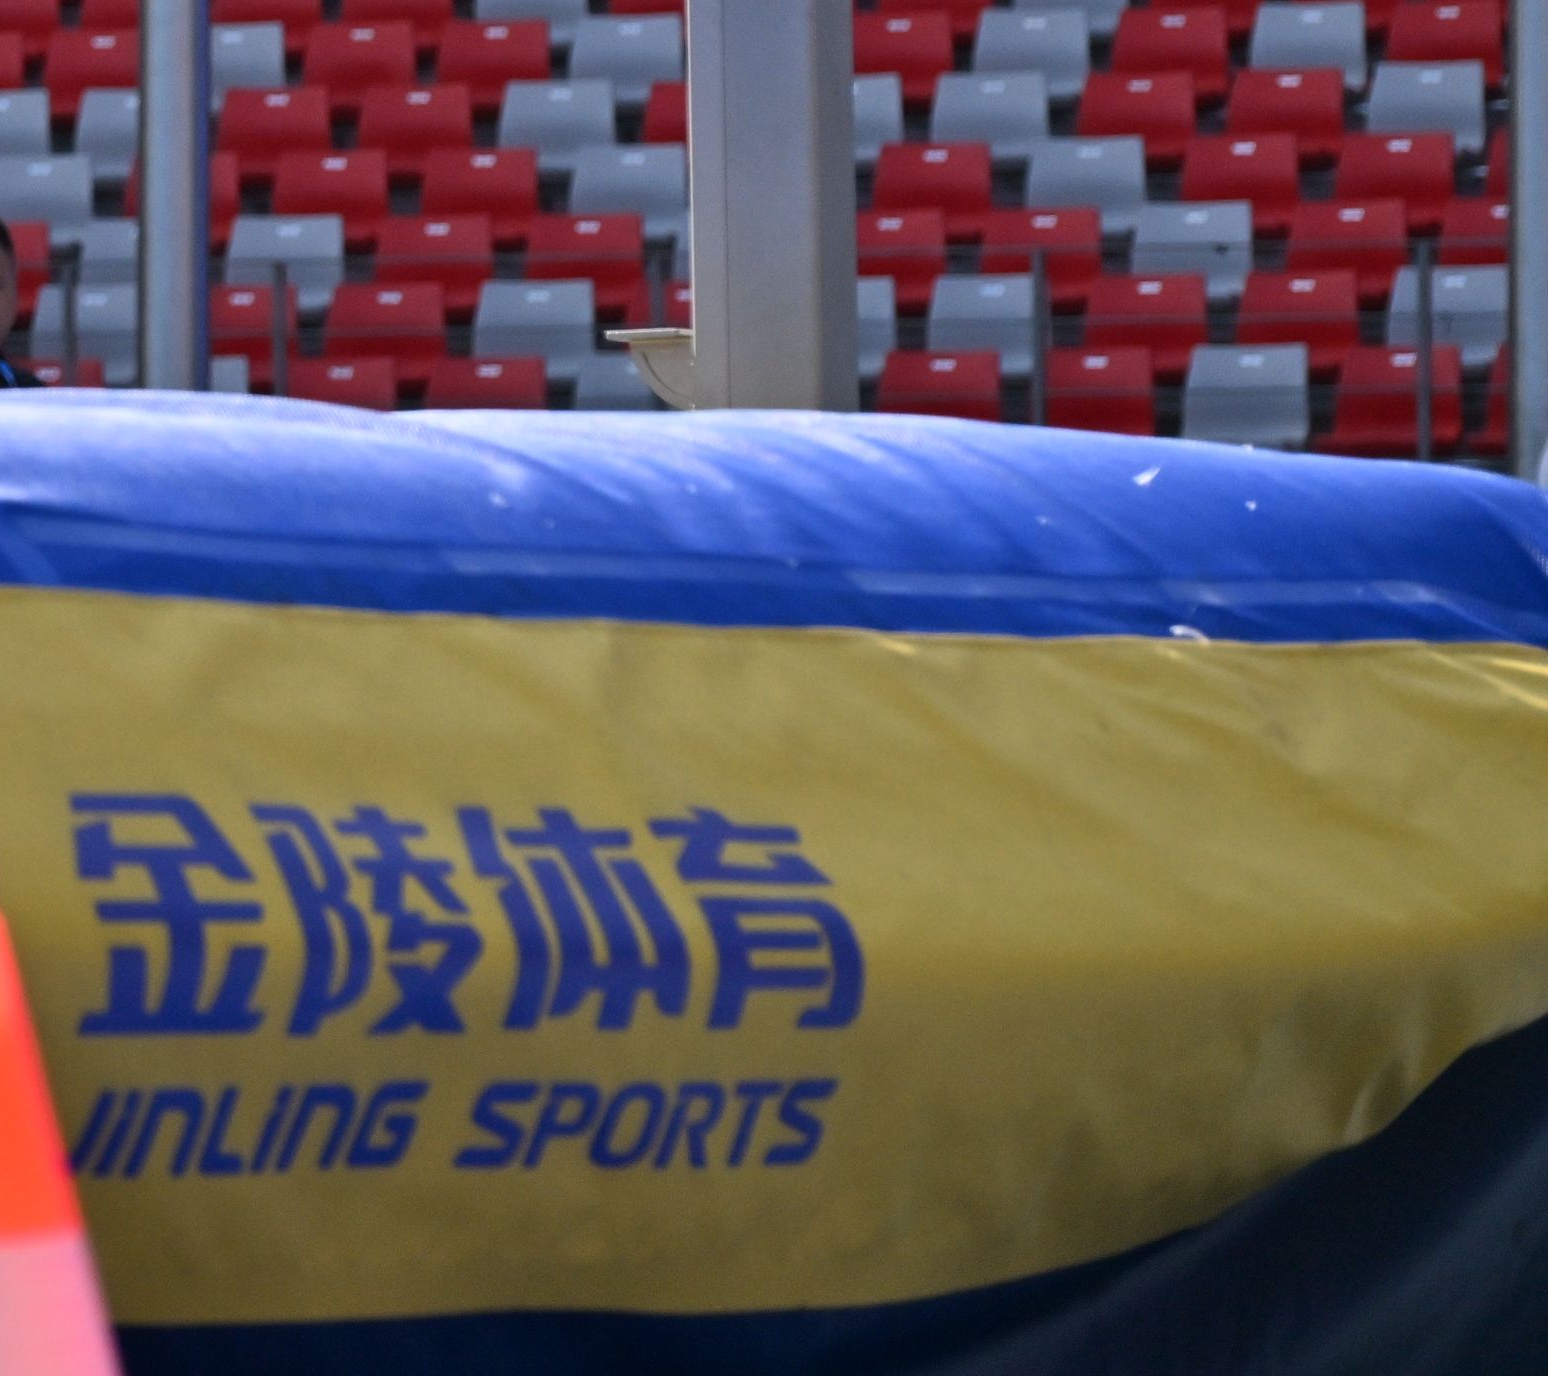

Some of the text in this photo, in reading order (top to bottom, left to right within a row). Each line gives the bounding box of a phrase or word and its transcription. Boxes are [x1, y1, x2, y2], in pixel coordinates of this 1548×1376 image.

[69, 791, 866, 1038] 金陵体育
[452, 1077, 840, 1173] SPORTS
